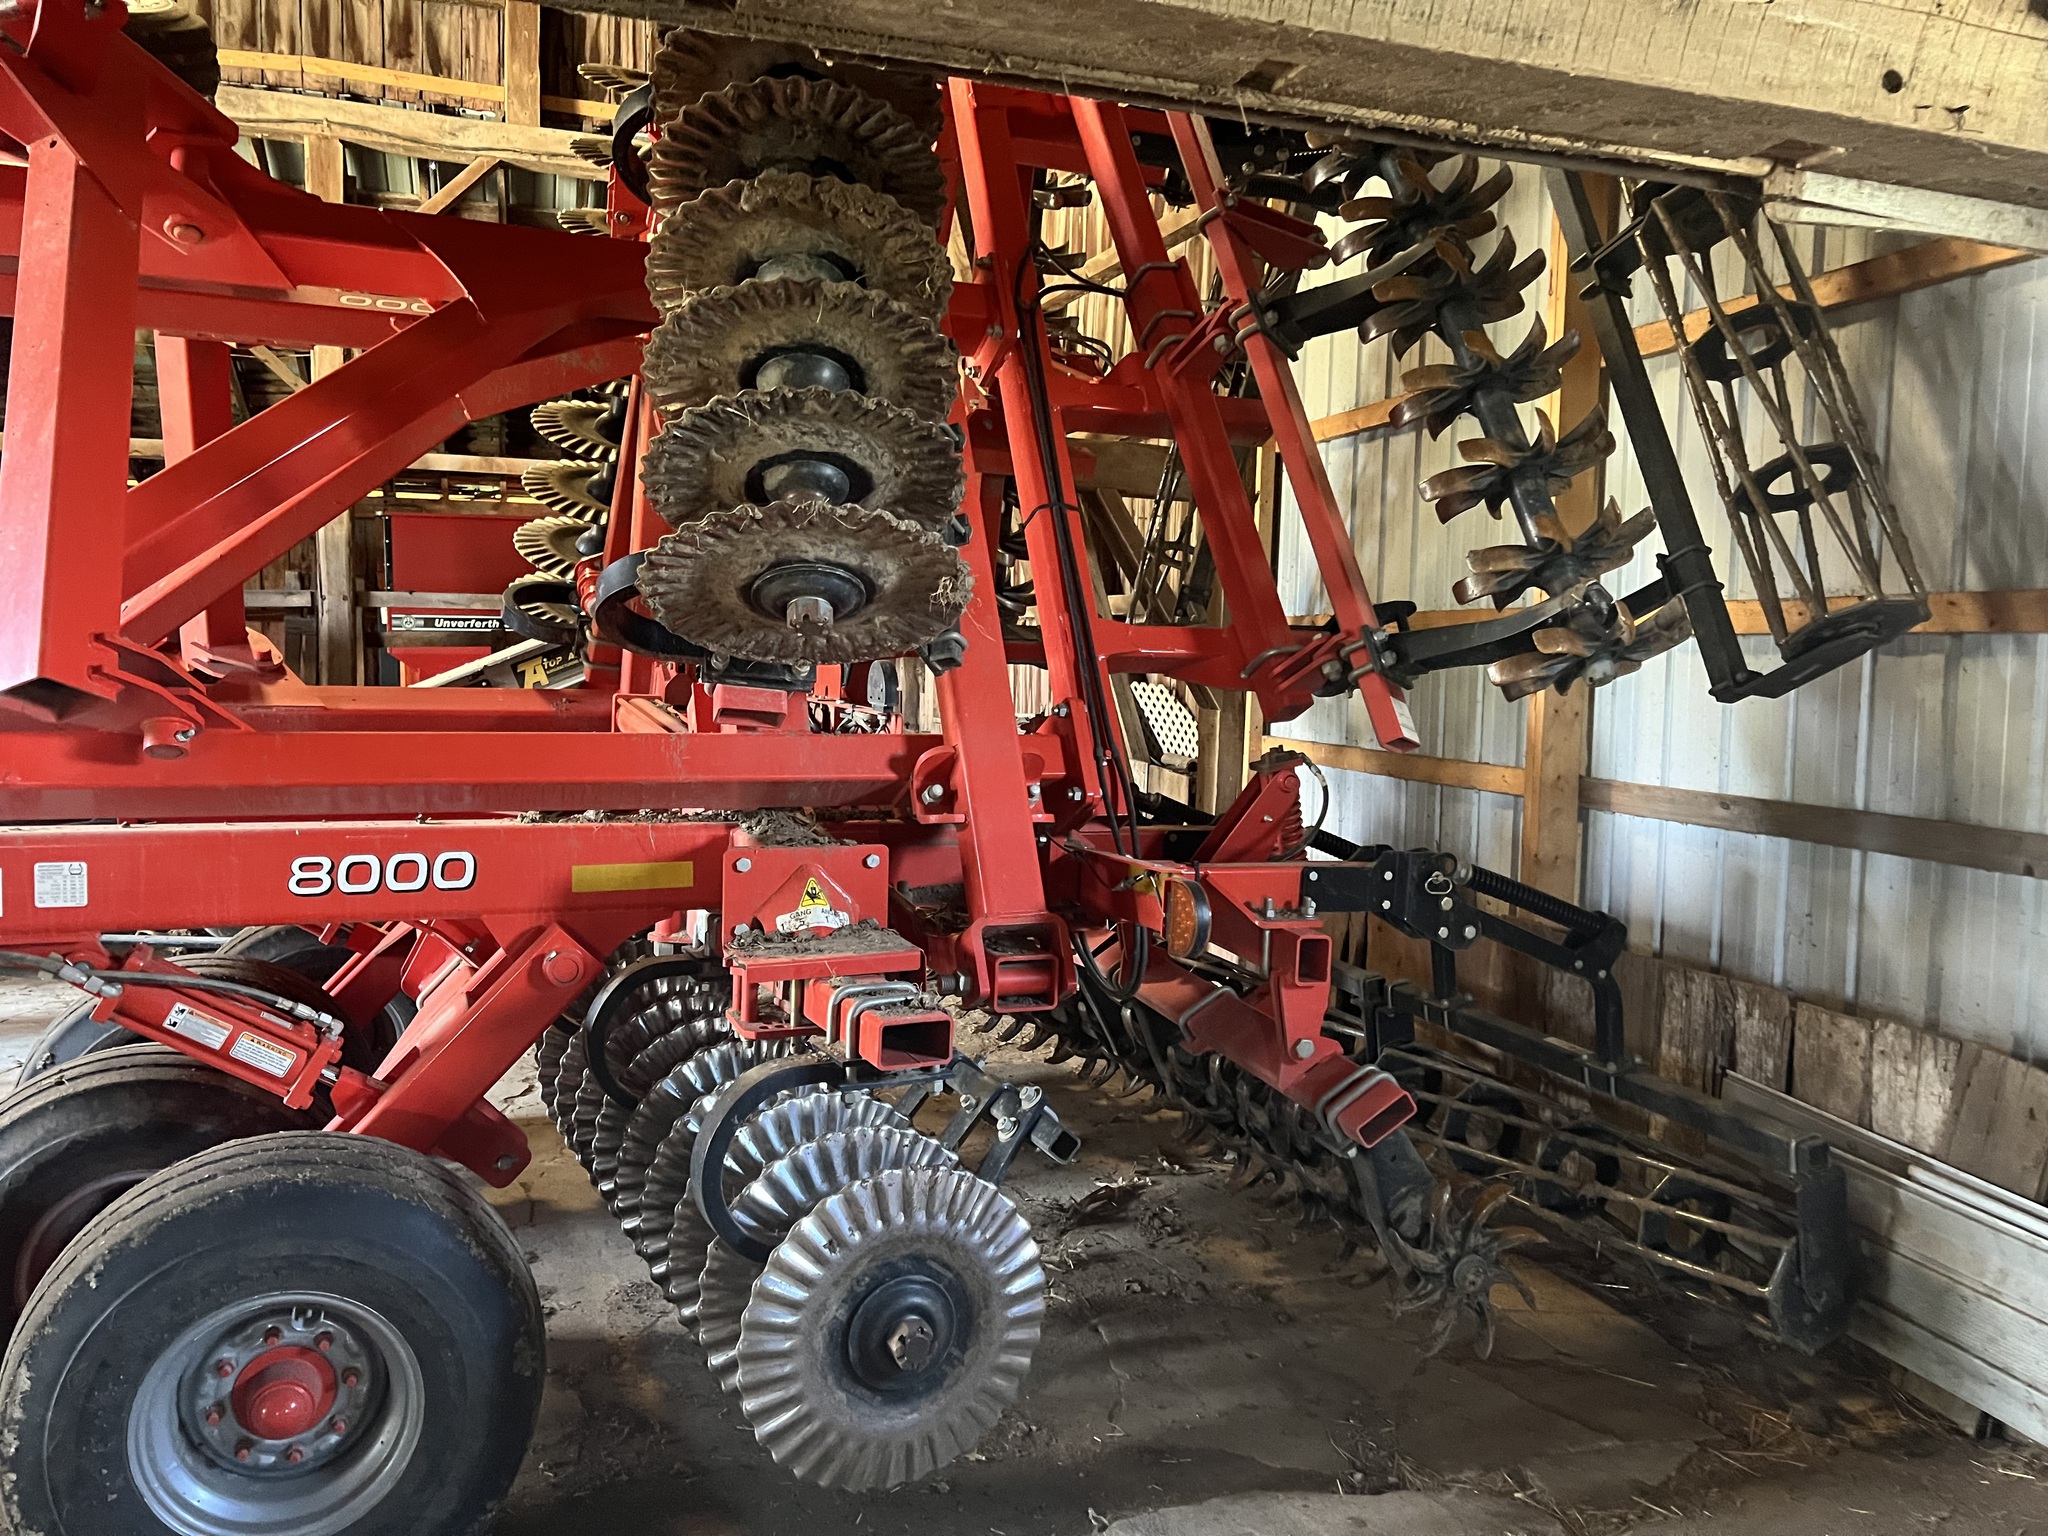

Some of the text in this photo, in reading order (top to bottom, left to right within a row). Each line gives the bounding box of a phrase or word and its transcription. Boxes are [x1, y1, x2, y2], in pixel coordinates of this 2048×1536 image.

[434, 618, 500, 629] Unverferth
[542, 656, 563, 670] TOP
[287, 851, 478, 897] 8000
[790, 908, 812, 919] GANG
[255, 1039, 288, 1057] WARNING
